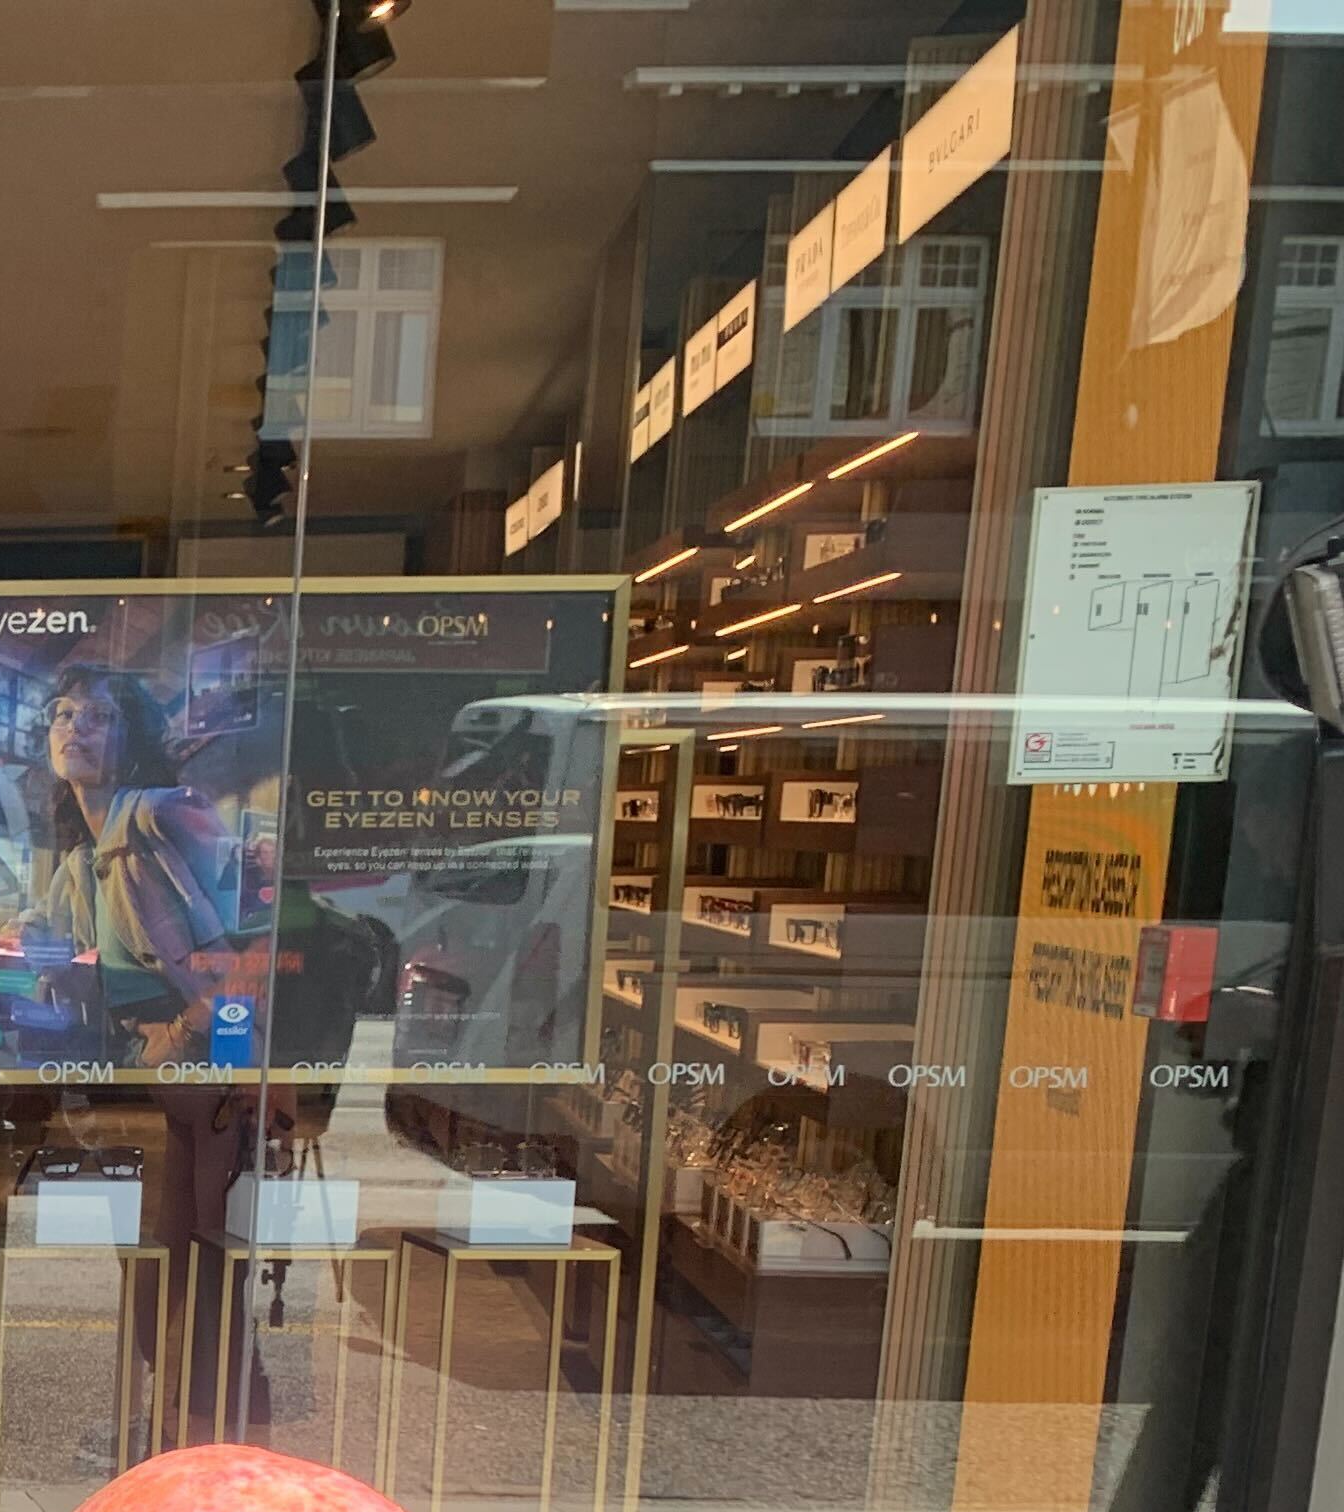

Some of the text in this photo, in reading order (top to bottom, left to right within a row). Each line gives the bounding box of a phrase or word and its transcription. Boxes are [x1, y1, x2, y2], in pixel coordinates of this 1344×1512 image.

[927, 108, 981, 173] BVLGARI
[417, 615, 489, 637] OPSM
[306, 789, 582, 808] GET TO KNOW YOUR
[324, 811, 560, 829] EYEZEN LENSES
[38, 1060, 114, 1085] OPSM
[156, 1061, 233, 1085] OPSM
[528, 1061, 606, 1084] OPSM
[647, 1061, 726, 1086] OPSM
[888, 1063, 967, 1088] OPSM
[1009, 1064, 1089, 1089] OPSM
[1149, 1064, 1229, 1088] OPSM
